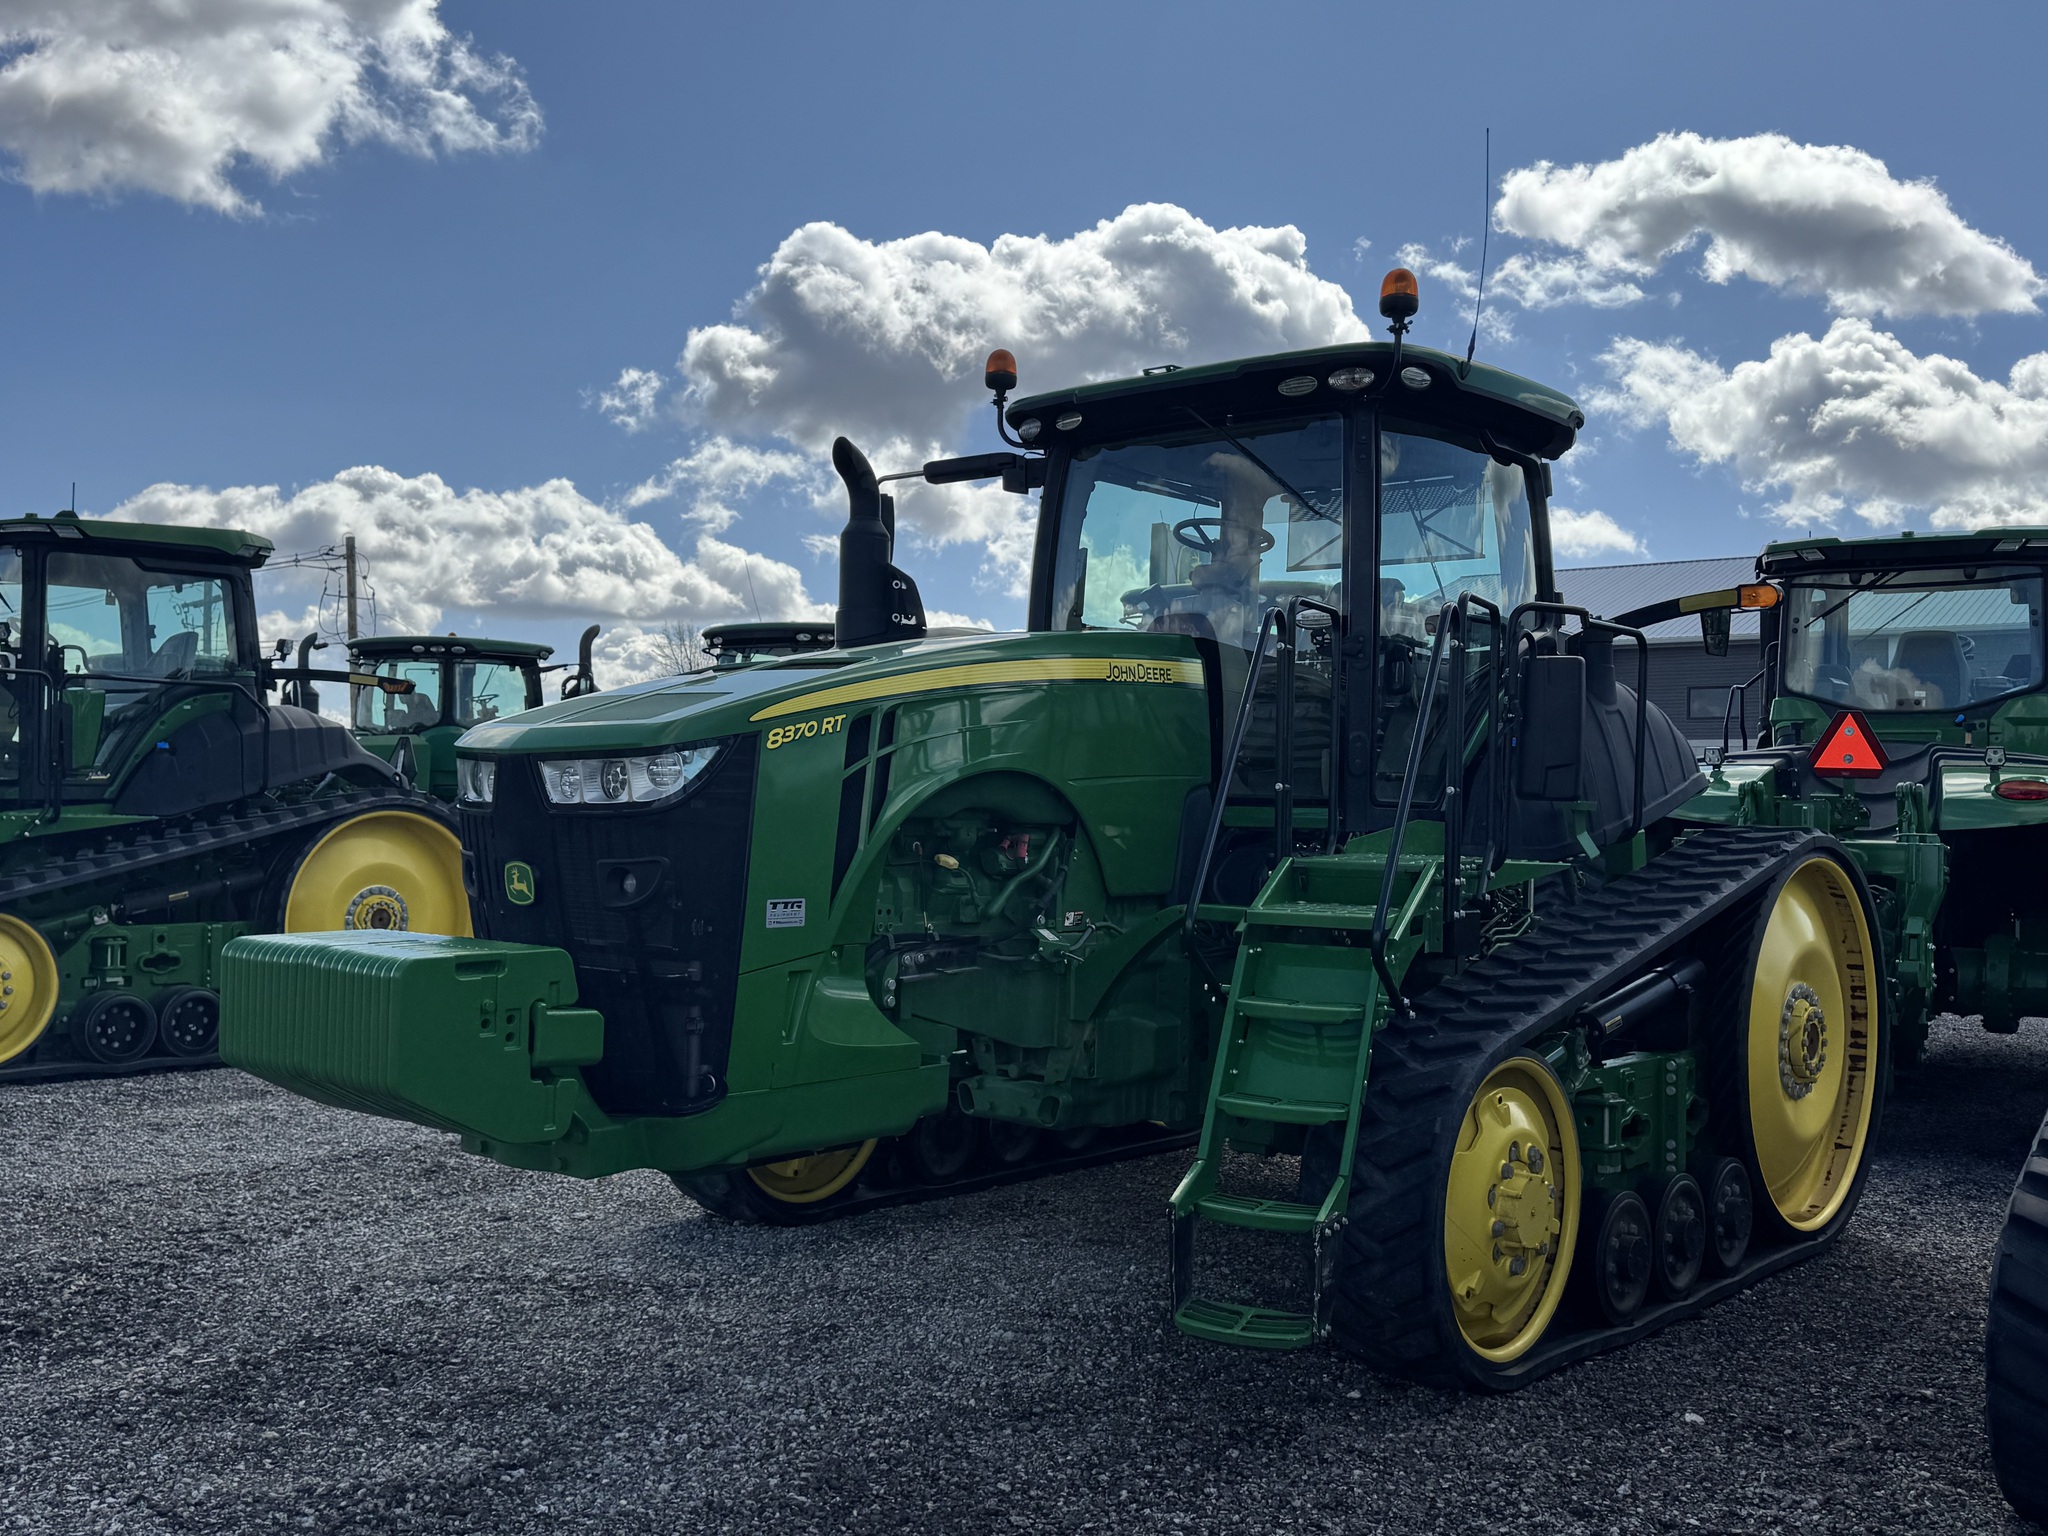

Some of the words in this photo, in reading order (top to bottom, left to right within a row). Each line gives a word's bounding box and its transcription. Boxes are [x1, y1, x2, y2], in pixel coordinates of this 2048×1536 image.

[766, 720, 819, 750] 8370
[820, 714, 847, 736] RT
[770, 900, 803, 910] TTG
